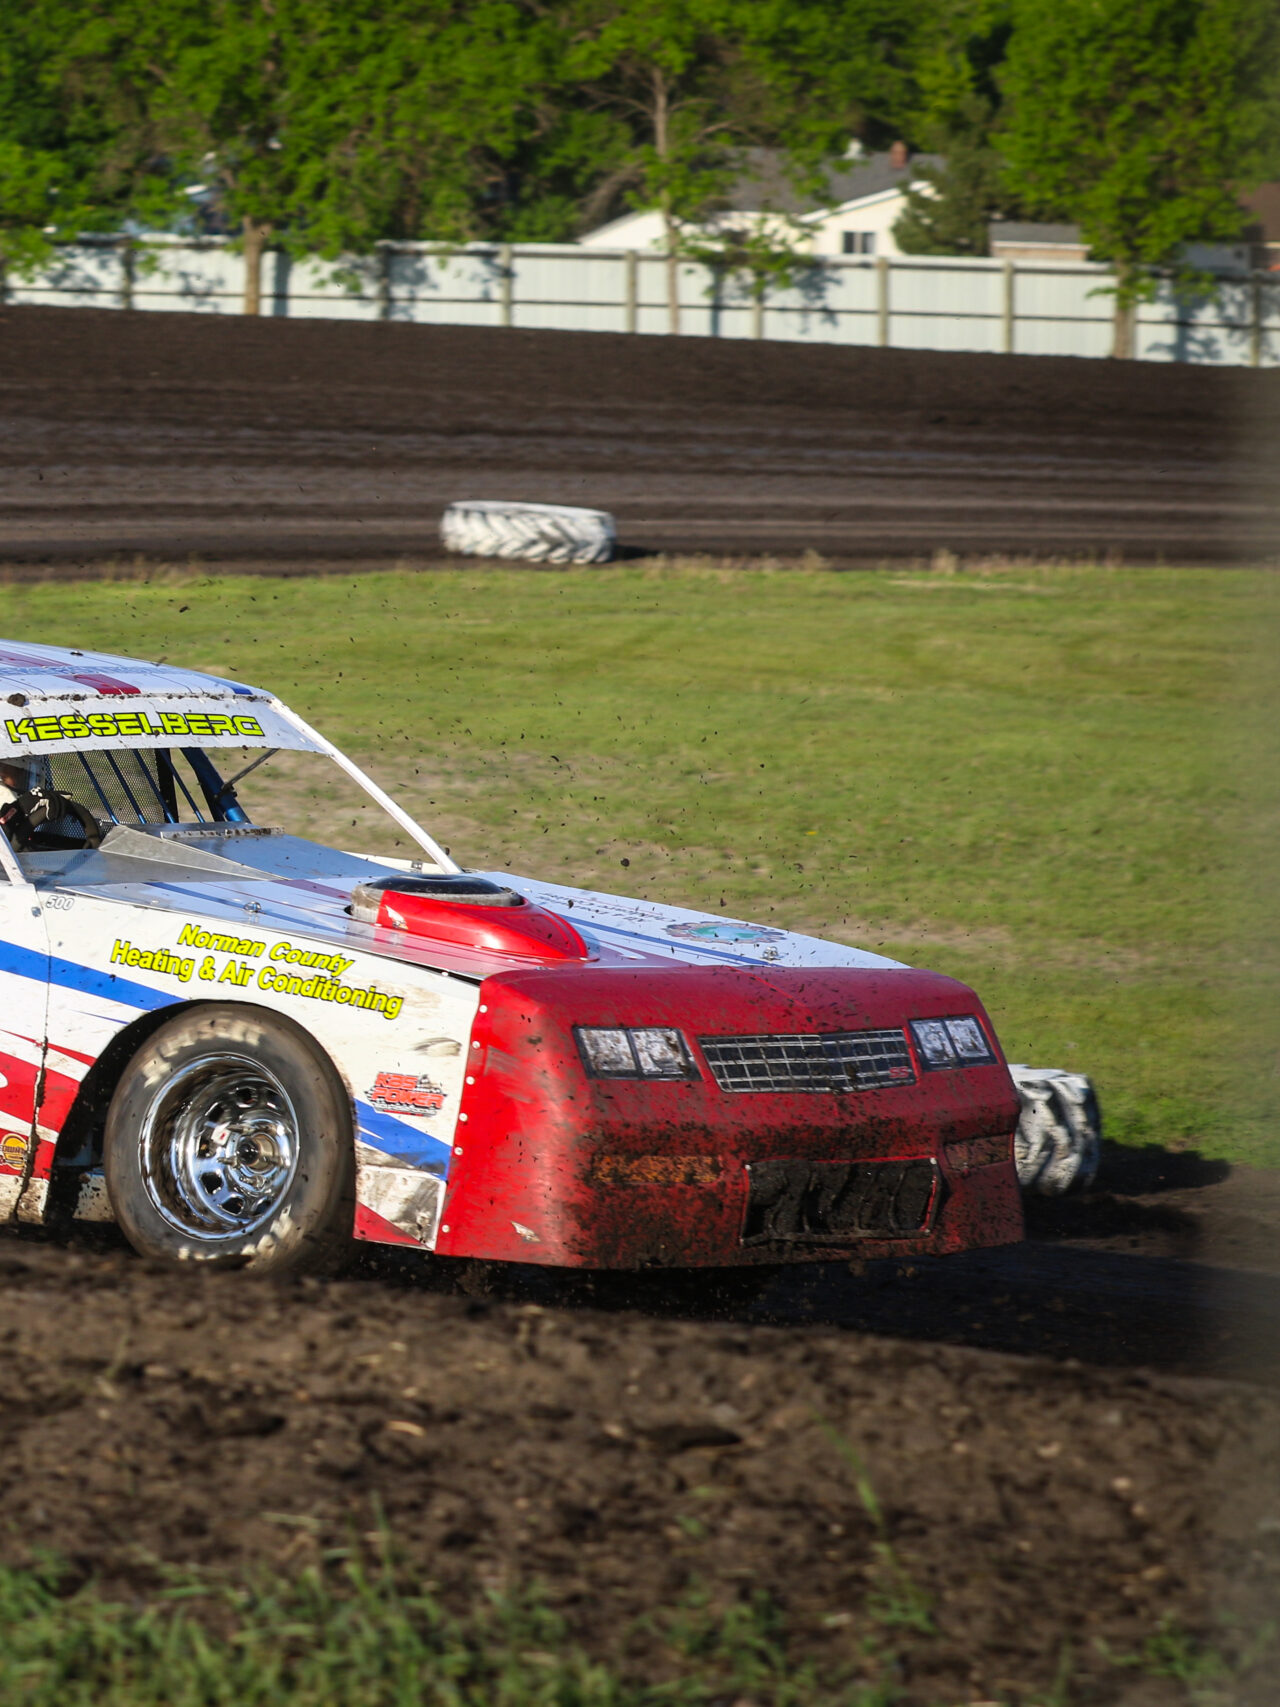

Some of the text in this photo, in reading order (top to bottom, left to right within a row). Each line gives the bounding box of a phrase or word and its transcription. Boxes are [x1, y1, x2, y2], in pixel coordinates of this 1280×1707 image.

[4, 711, 265, 743] KESSELBERG
[46, 895, 74, 910] 500
[177, 923, 356, 977] Norman County
[109, 939, 405, 1020] Heating & Air Conditioning
[888, 1066, 910, 1079] SS
[371, 1086, 445, 1110] POWER
